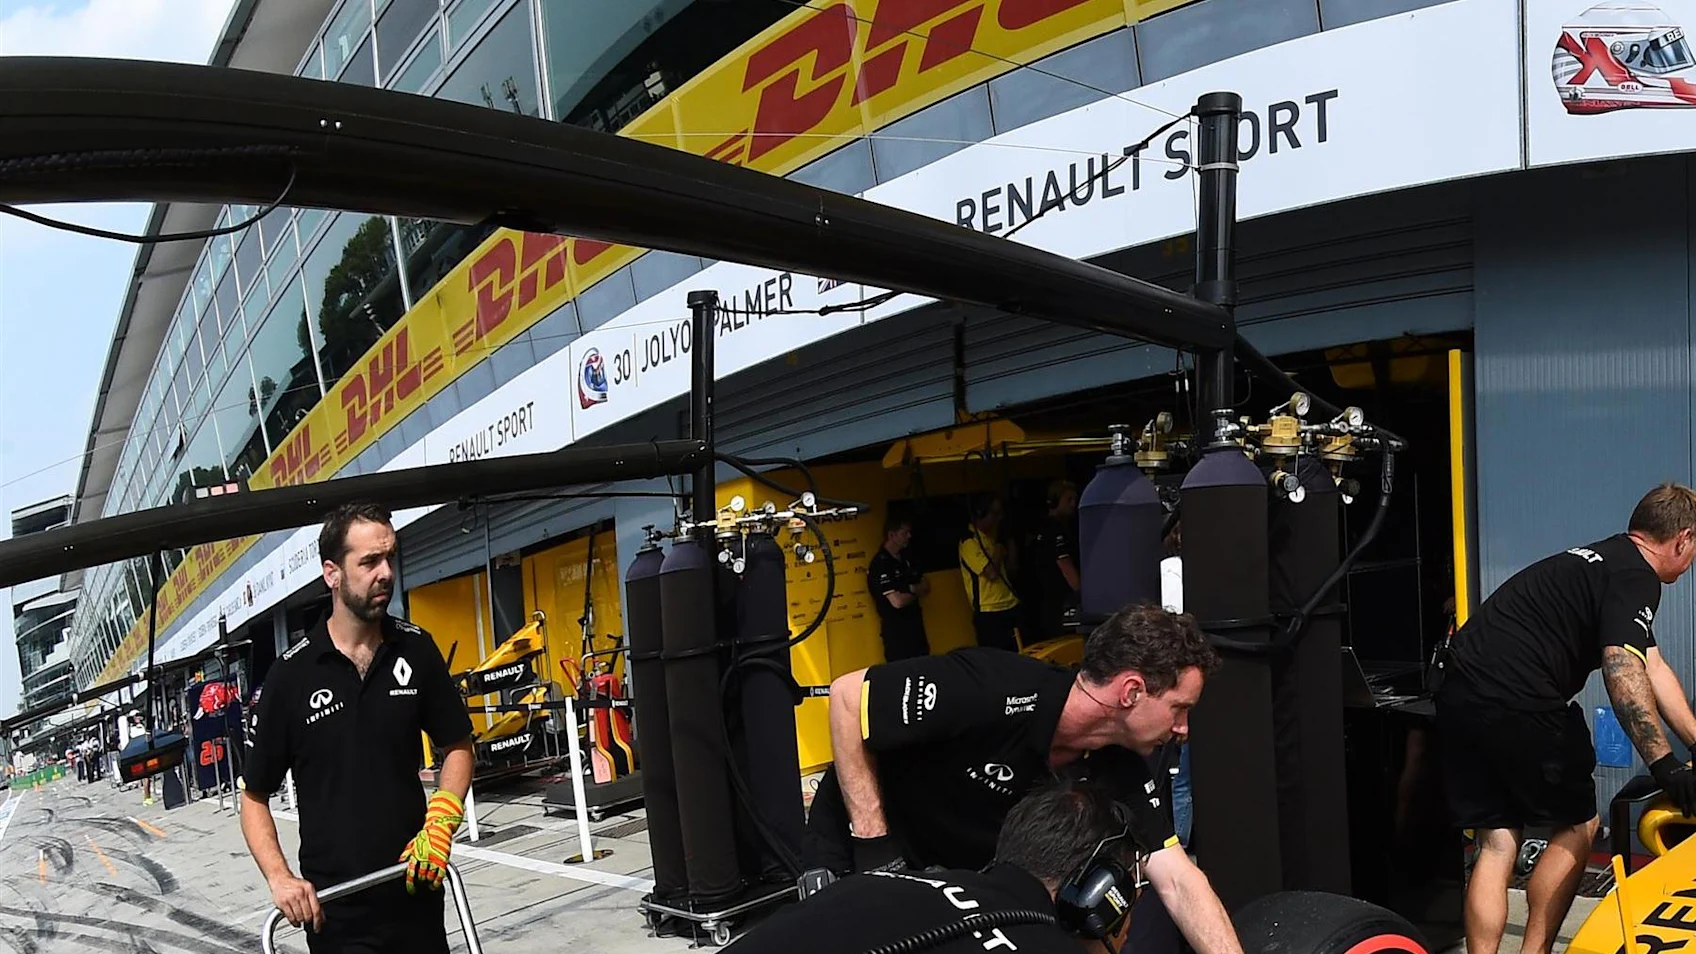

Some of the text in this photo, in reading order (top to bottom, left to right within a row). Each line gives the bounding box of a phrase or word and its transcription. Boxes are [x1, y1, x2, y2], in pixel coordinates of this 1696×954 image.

[742, 2, 1124, 162] DH
[956, 89, 1339, 235] RENAULT SORT
[613, 349, 631, 385] 30
[641, 319, 693, 373] JOLYO
[341, 326, 422, 447] DHL
[449, 401, 534, 463] RENAULT SPORT
[389, 688, 418, 696] RENAULT
[484, 663, 525, 683] RENAULT
[305, 701, 344, 725] INFINITI
[491, 733, 531, 752] RENAULT
